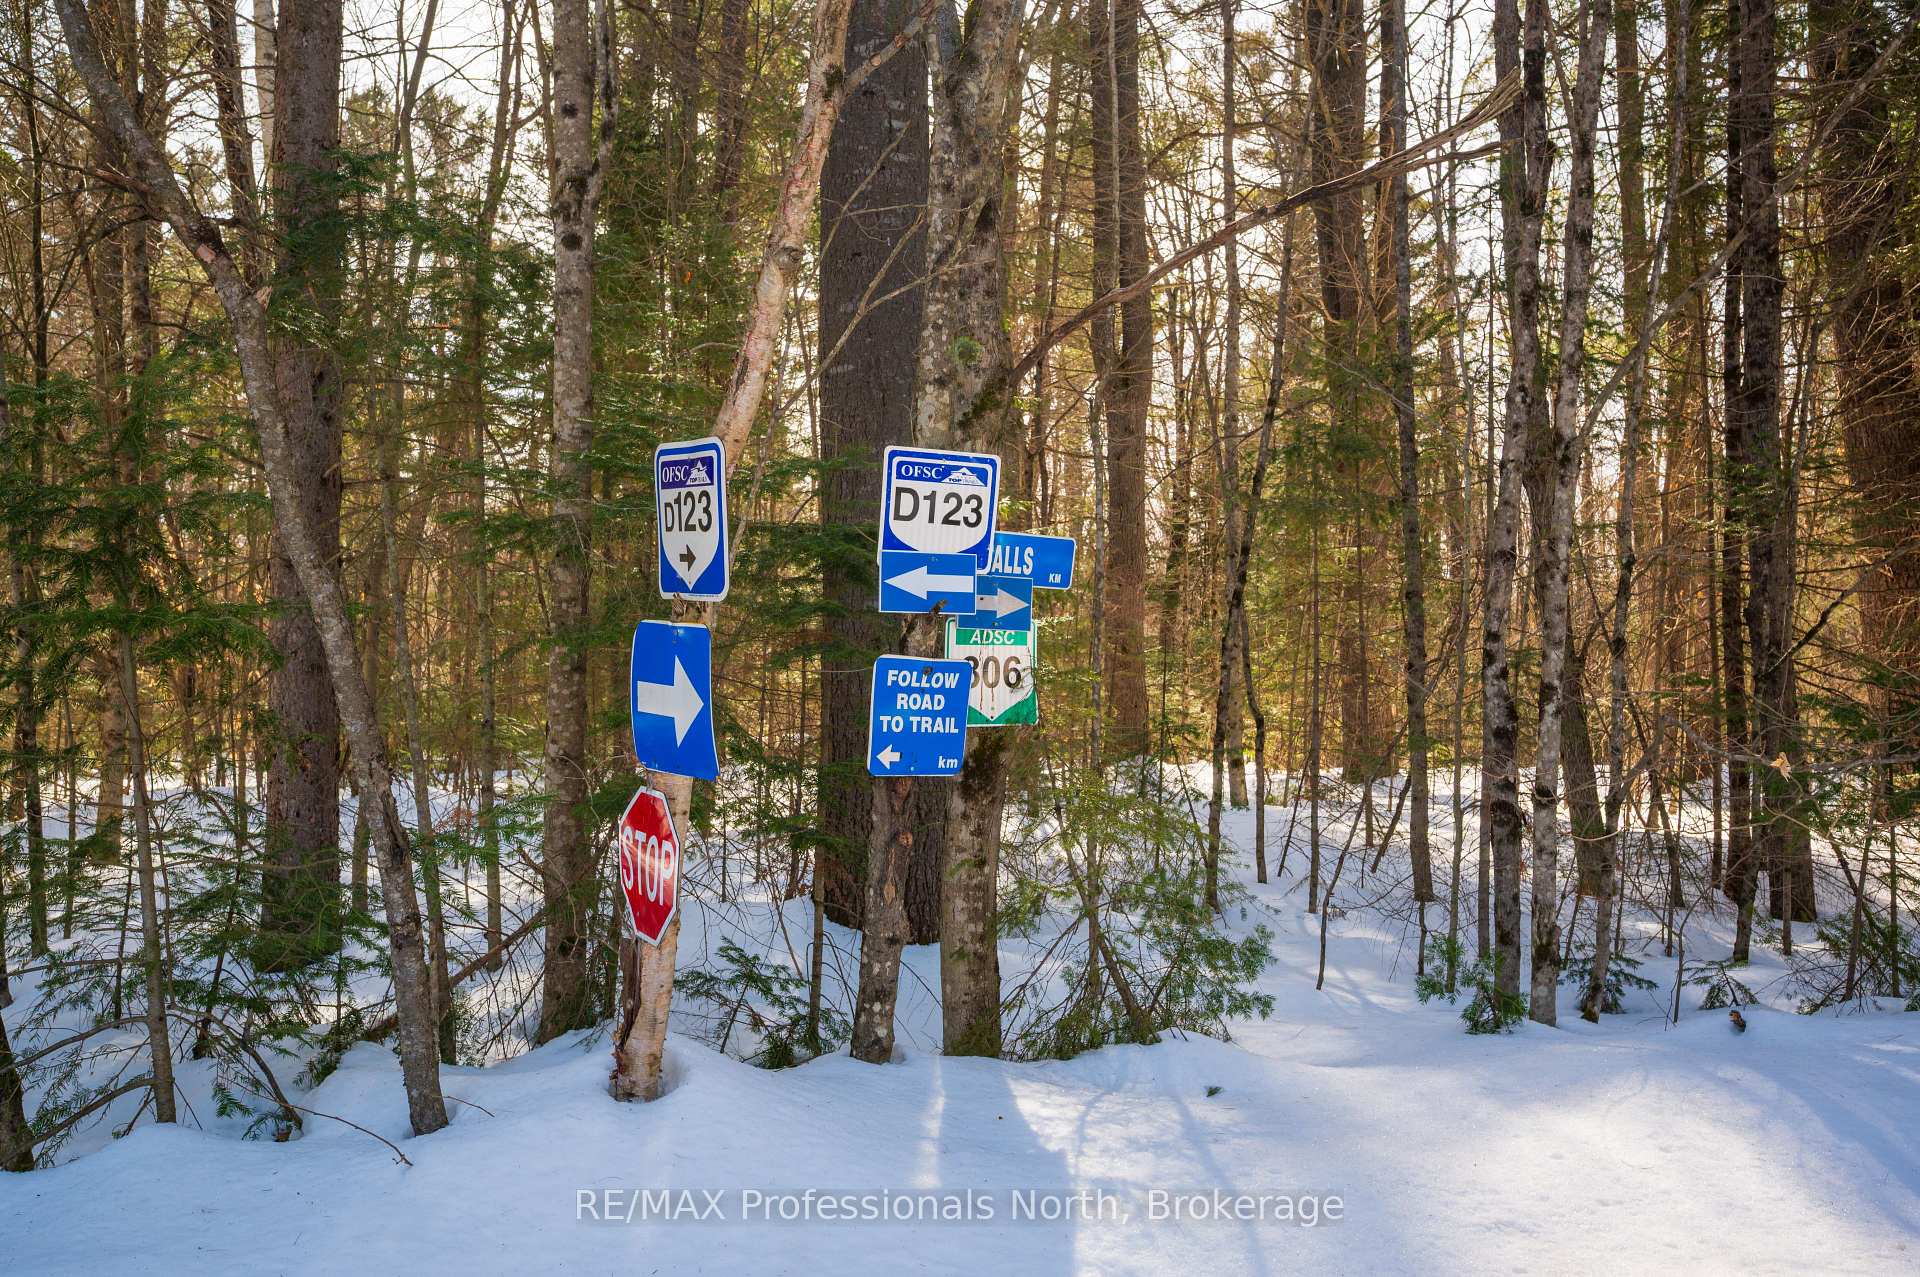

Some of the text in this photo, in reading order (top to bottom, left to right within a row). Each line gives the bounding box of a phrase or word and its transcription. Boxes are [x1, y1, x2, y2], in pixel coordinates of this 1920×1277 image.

[662, 465, 689, 483] OFSC
[901, 464, 943, 479] OFSC
[664, 490, 713, 532] D123
[893, 486, 983, 528] D123
[991, 544, 1034, 575] ALLS
[1048, 573, 1062, 583] KM
[969, 629, 1015, 644] ADSC
[887, 669, 960, 689] FOLLOW
[896, 693, 945, 710] ROAD
[880, 715, 959, 734] TO TRAIL
[938, 755, 958, 769] km
[622, 825, 675, 906] STOP
